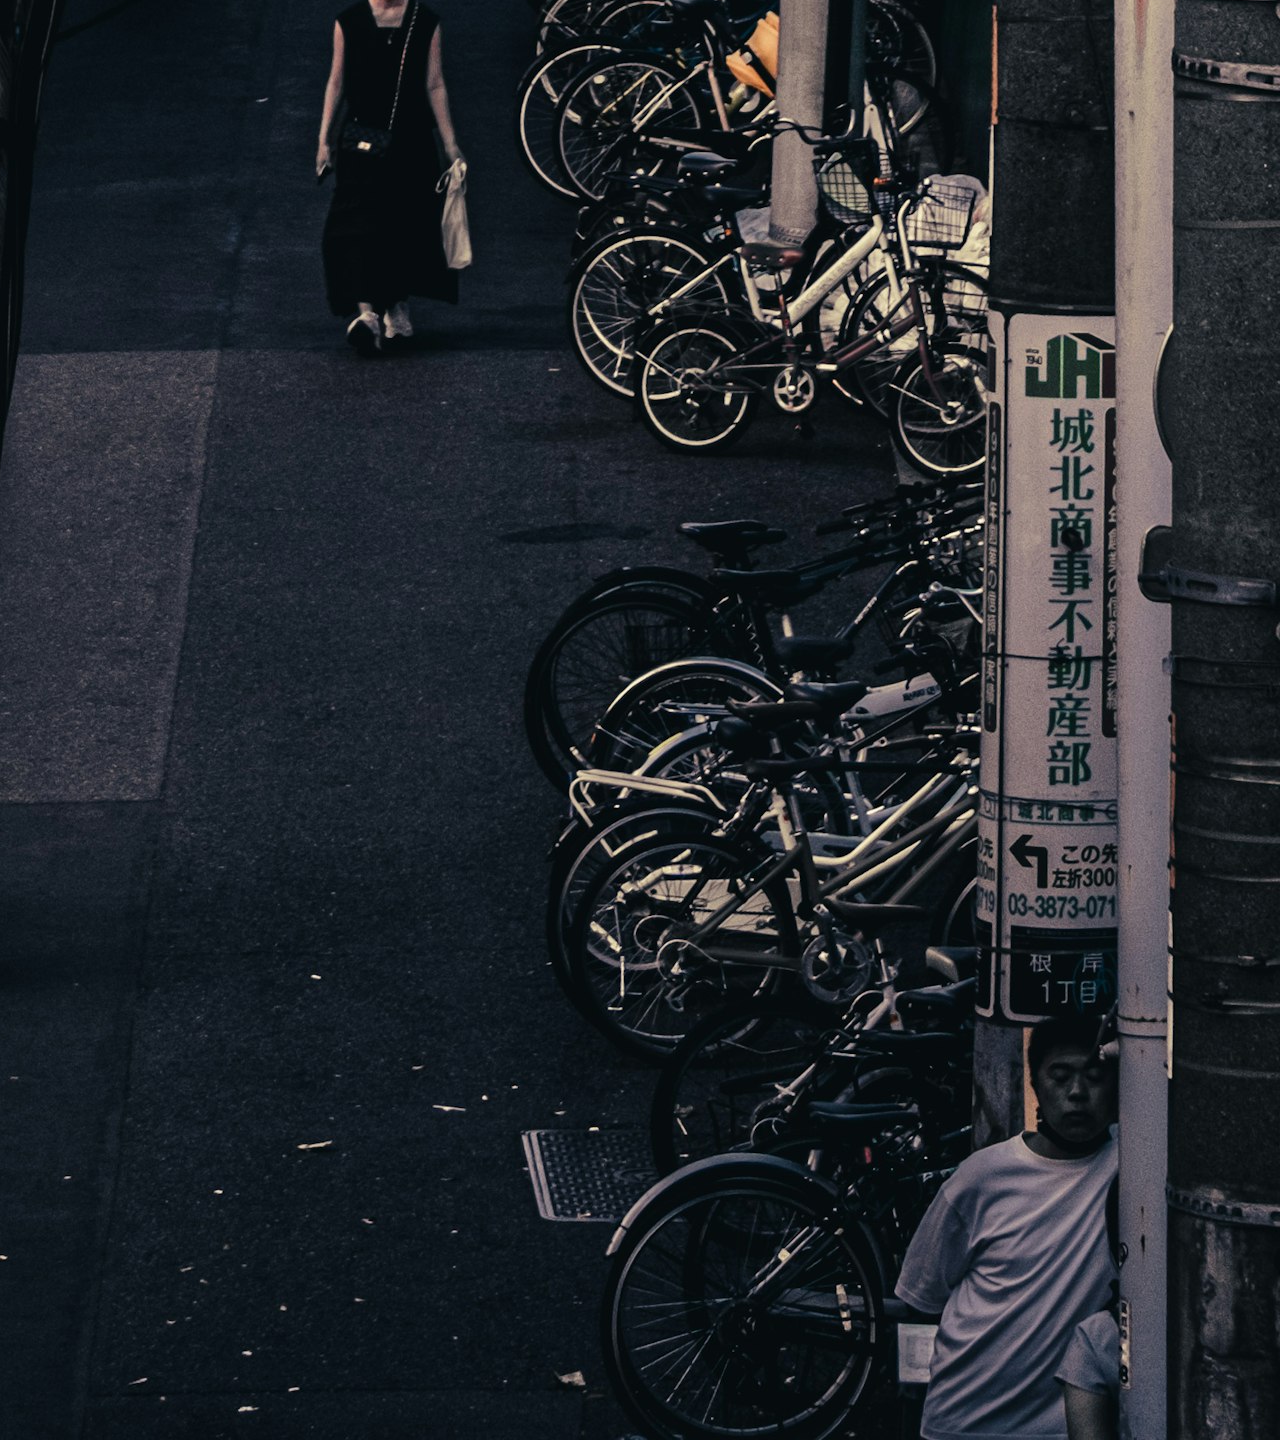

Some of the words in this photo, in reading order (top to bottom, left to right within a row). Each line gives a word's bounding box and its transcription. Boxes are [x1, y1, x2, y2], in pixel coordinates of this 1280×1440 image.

[1045, 407, 1095, 788] 城北商事不動産部
[1041, 980, 1098, 1005] 1丁目
